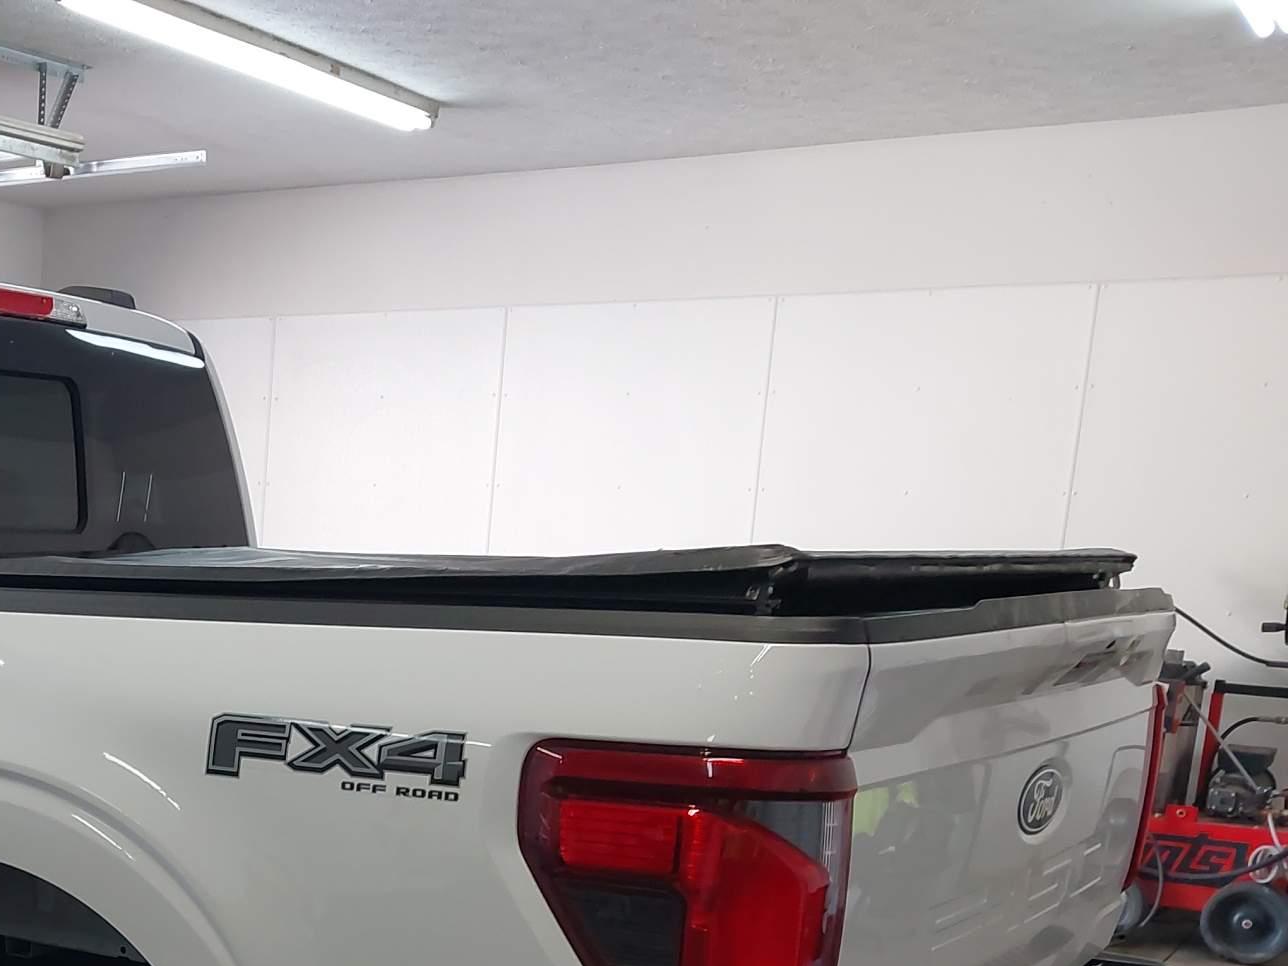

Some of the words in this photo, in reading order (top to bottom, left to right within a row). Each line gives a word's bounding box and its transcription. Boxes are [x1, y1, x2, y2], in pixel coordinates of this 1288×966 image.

[206, 713, 467, 787] FX4
[340, 780, 387, 795] OFF
[395, 786, 460, 803] ROAD
